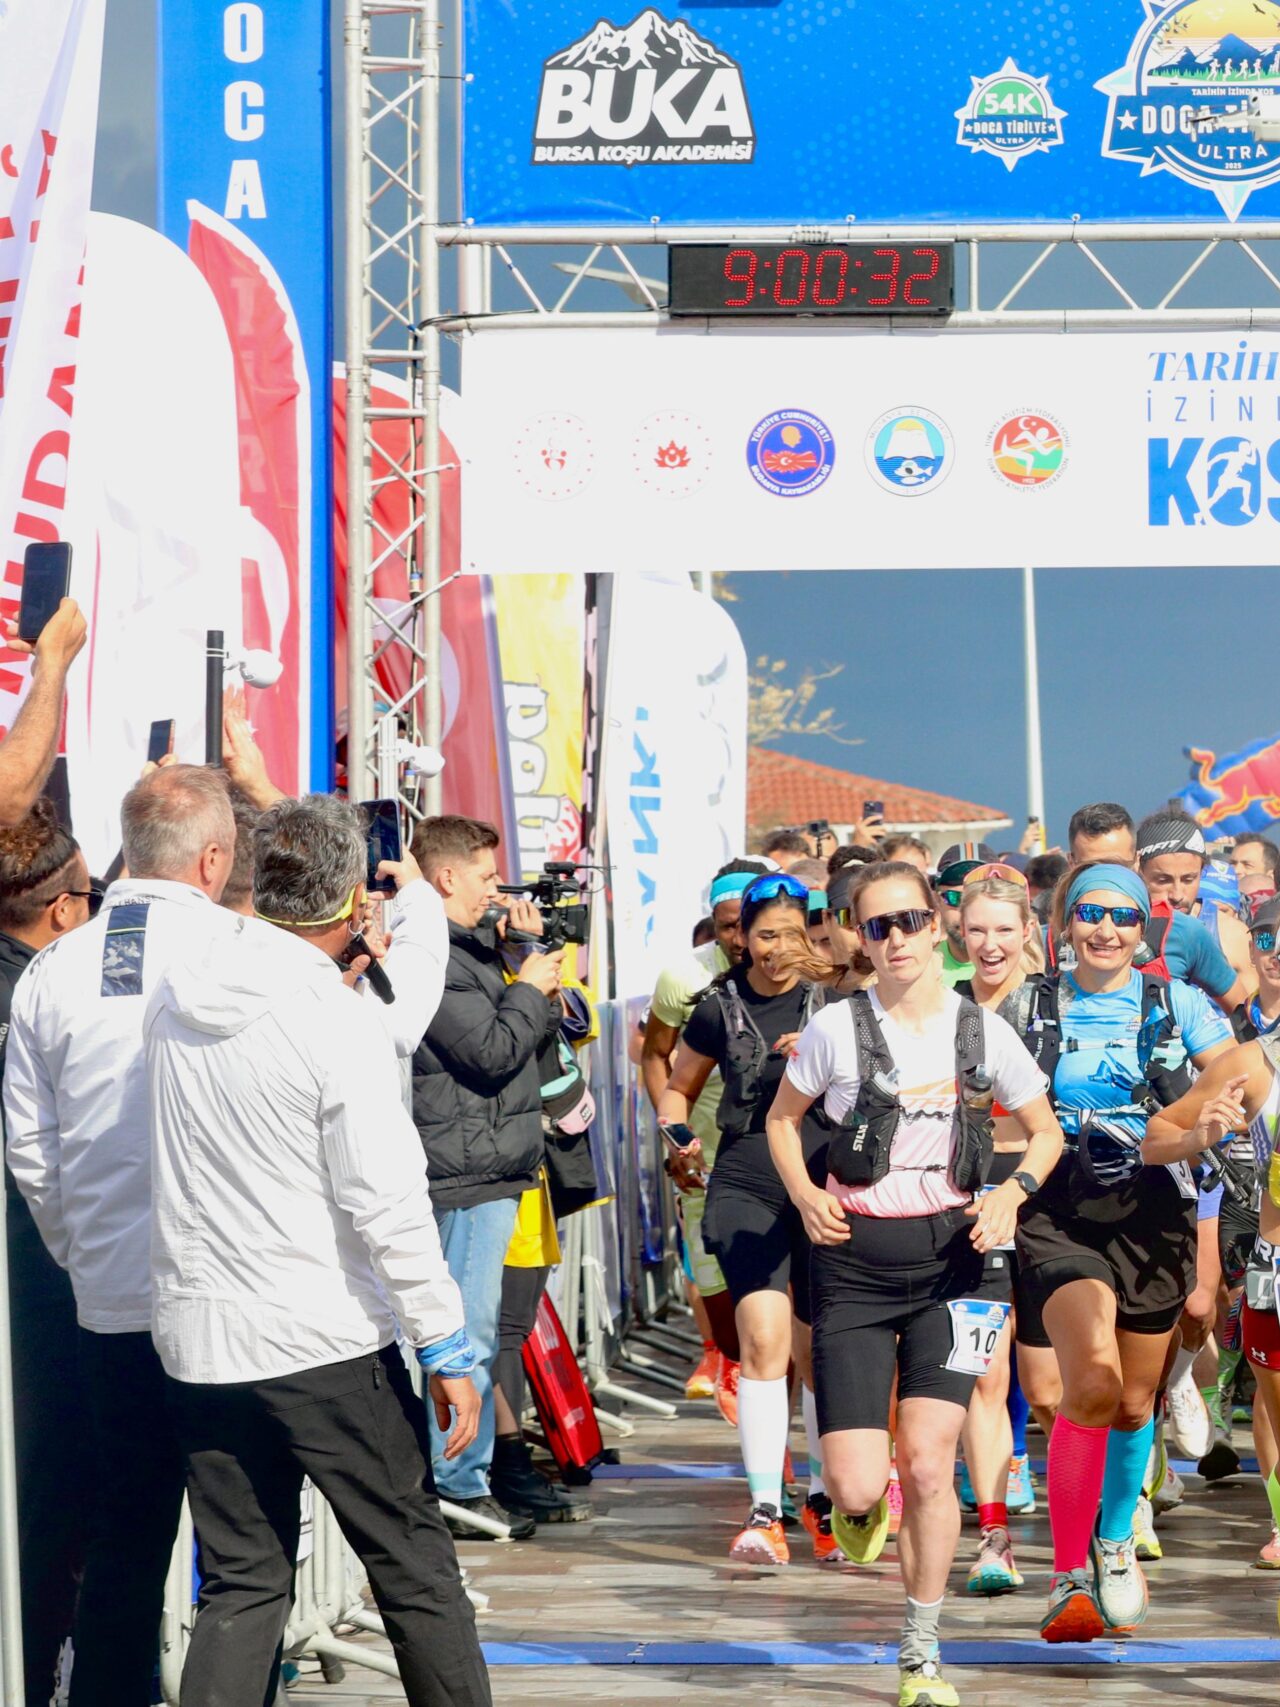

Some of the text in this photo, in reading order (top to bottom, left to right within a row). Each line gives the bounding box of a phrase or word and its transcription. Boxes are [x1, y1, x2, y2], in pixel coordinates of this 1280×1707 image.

[535, 68, 753, 141] BUKA
[984, 92, 1038, 115] 54K
[974, 119, 1048, 135] DOCA TİRİLYE
[995, 136, 1025, 145] ULTRA
[534, 140, 754, 164] BURSA KOŞU AKADEMİSİ
[1197, 143, 1269, 161] ULTRA
[1224, 162, 1243, 170] 2025
[723, 248, 941, 307] 9:00:32
